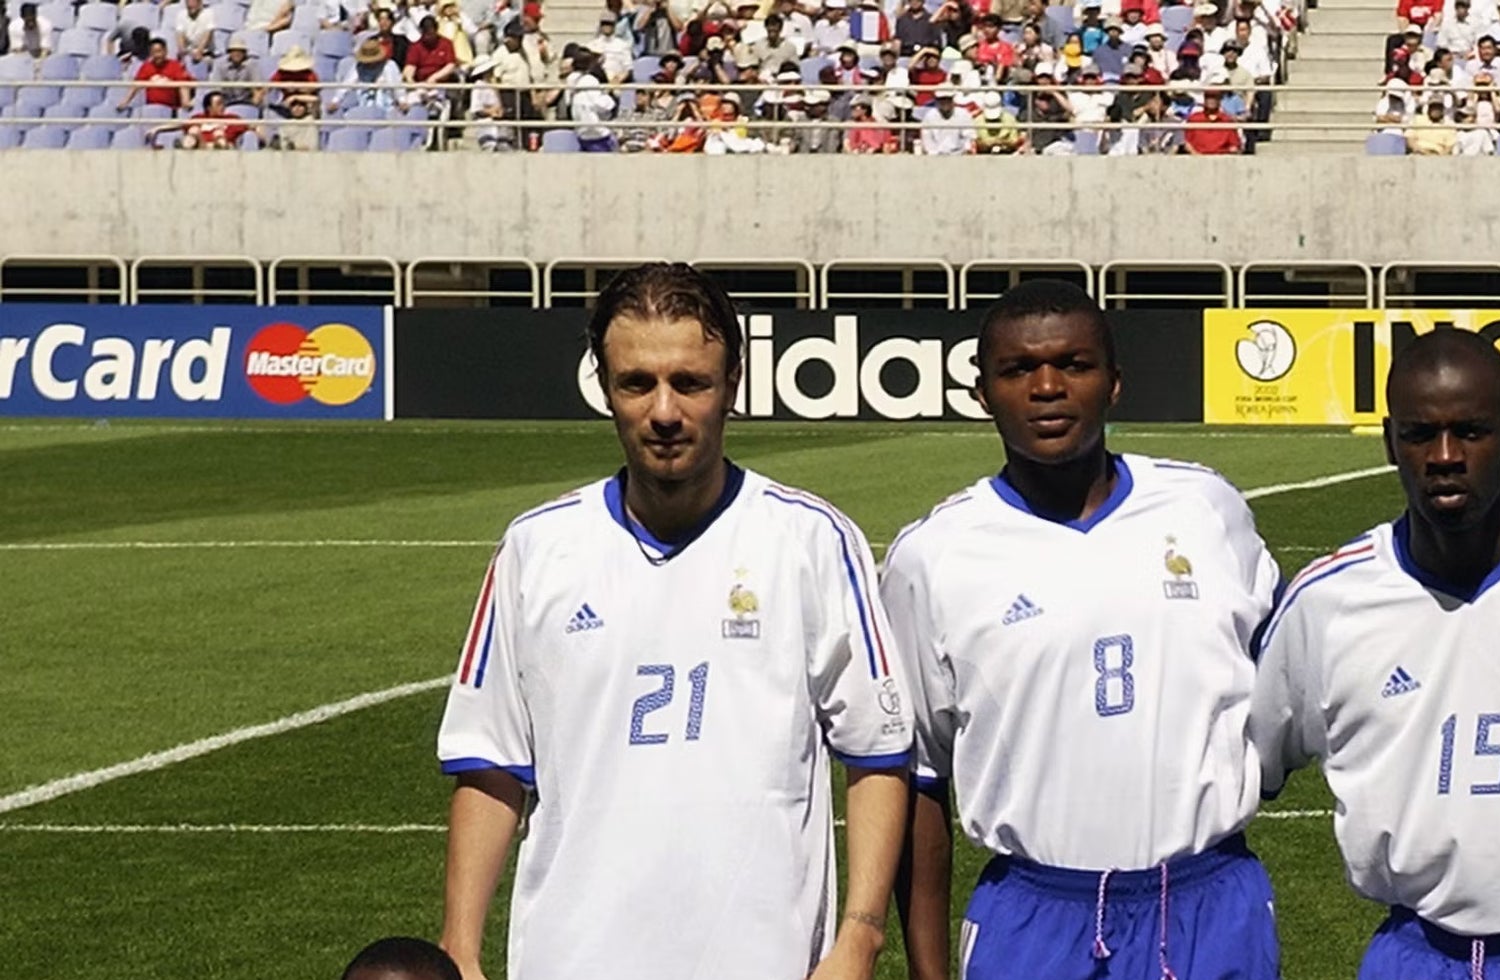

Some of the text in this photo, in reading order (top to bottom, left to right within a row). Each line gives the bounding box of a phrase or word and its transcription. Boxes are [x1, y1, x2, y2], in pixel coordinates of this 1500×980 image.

[246, 350, 372, 377] MasterCard
[577, 314, 997, 420] idas
[628, 660, 711, 746] 21
[1093, 633, 1136, 718] 8
